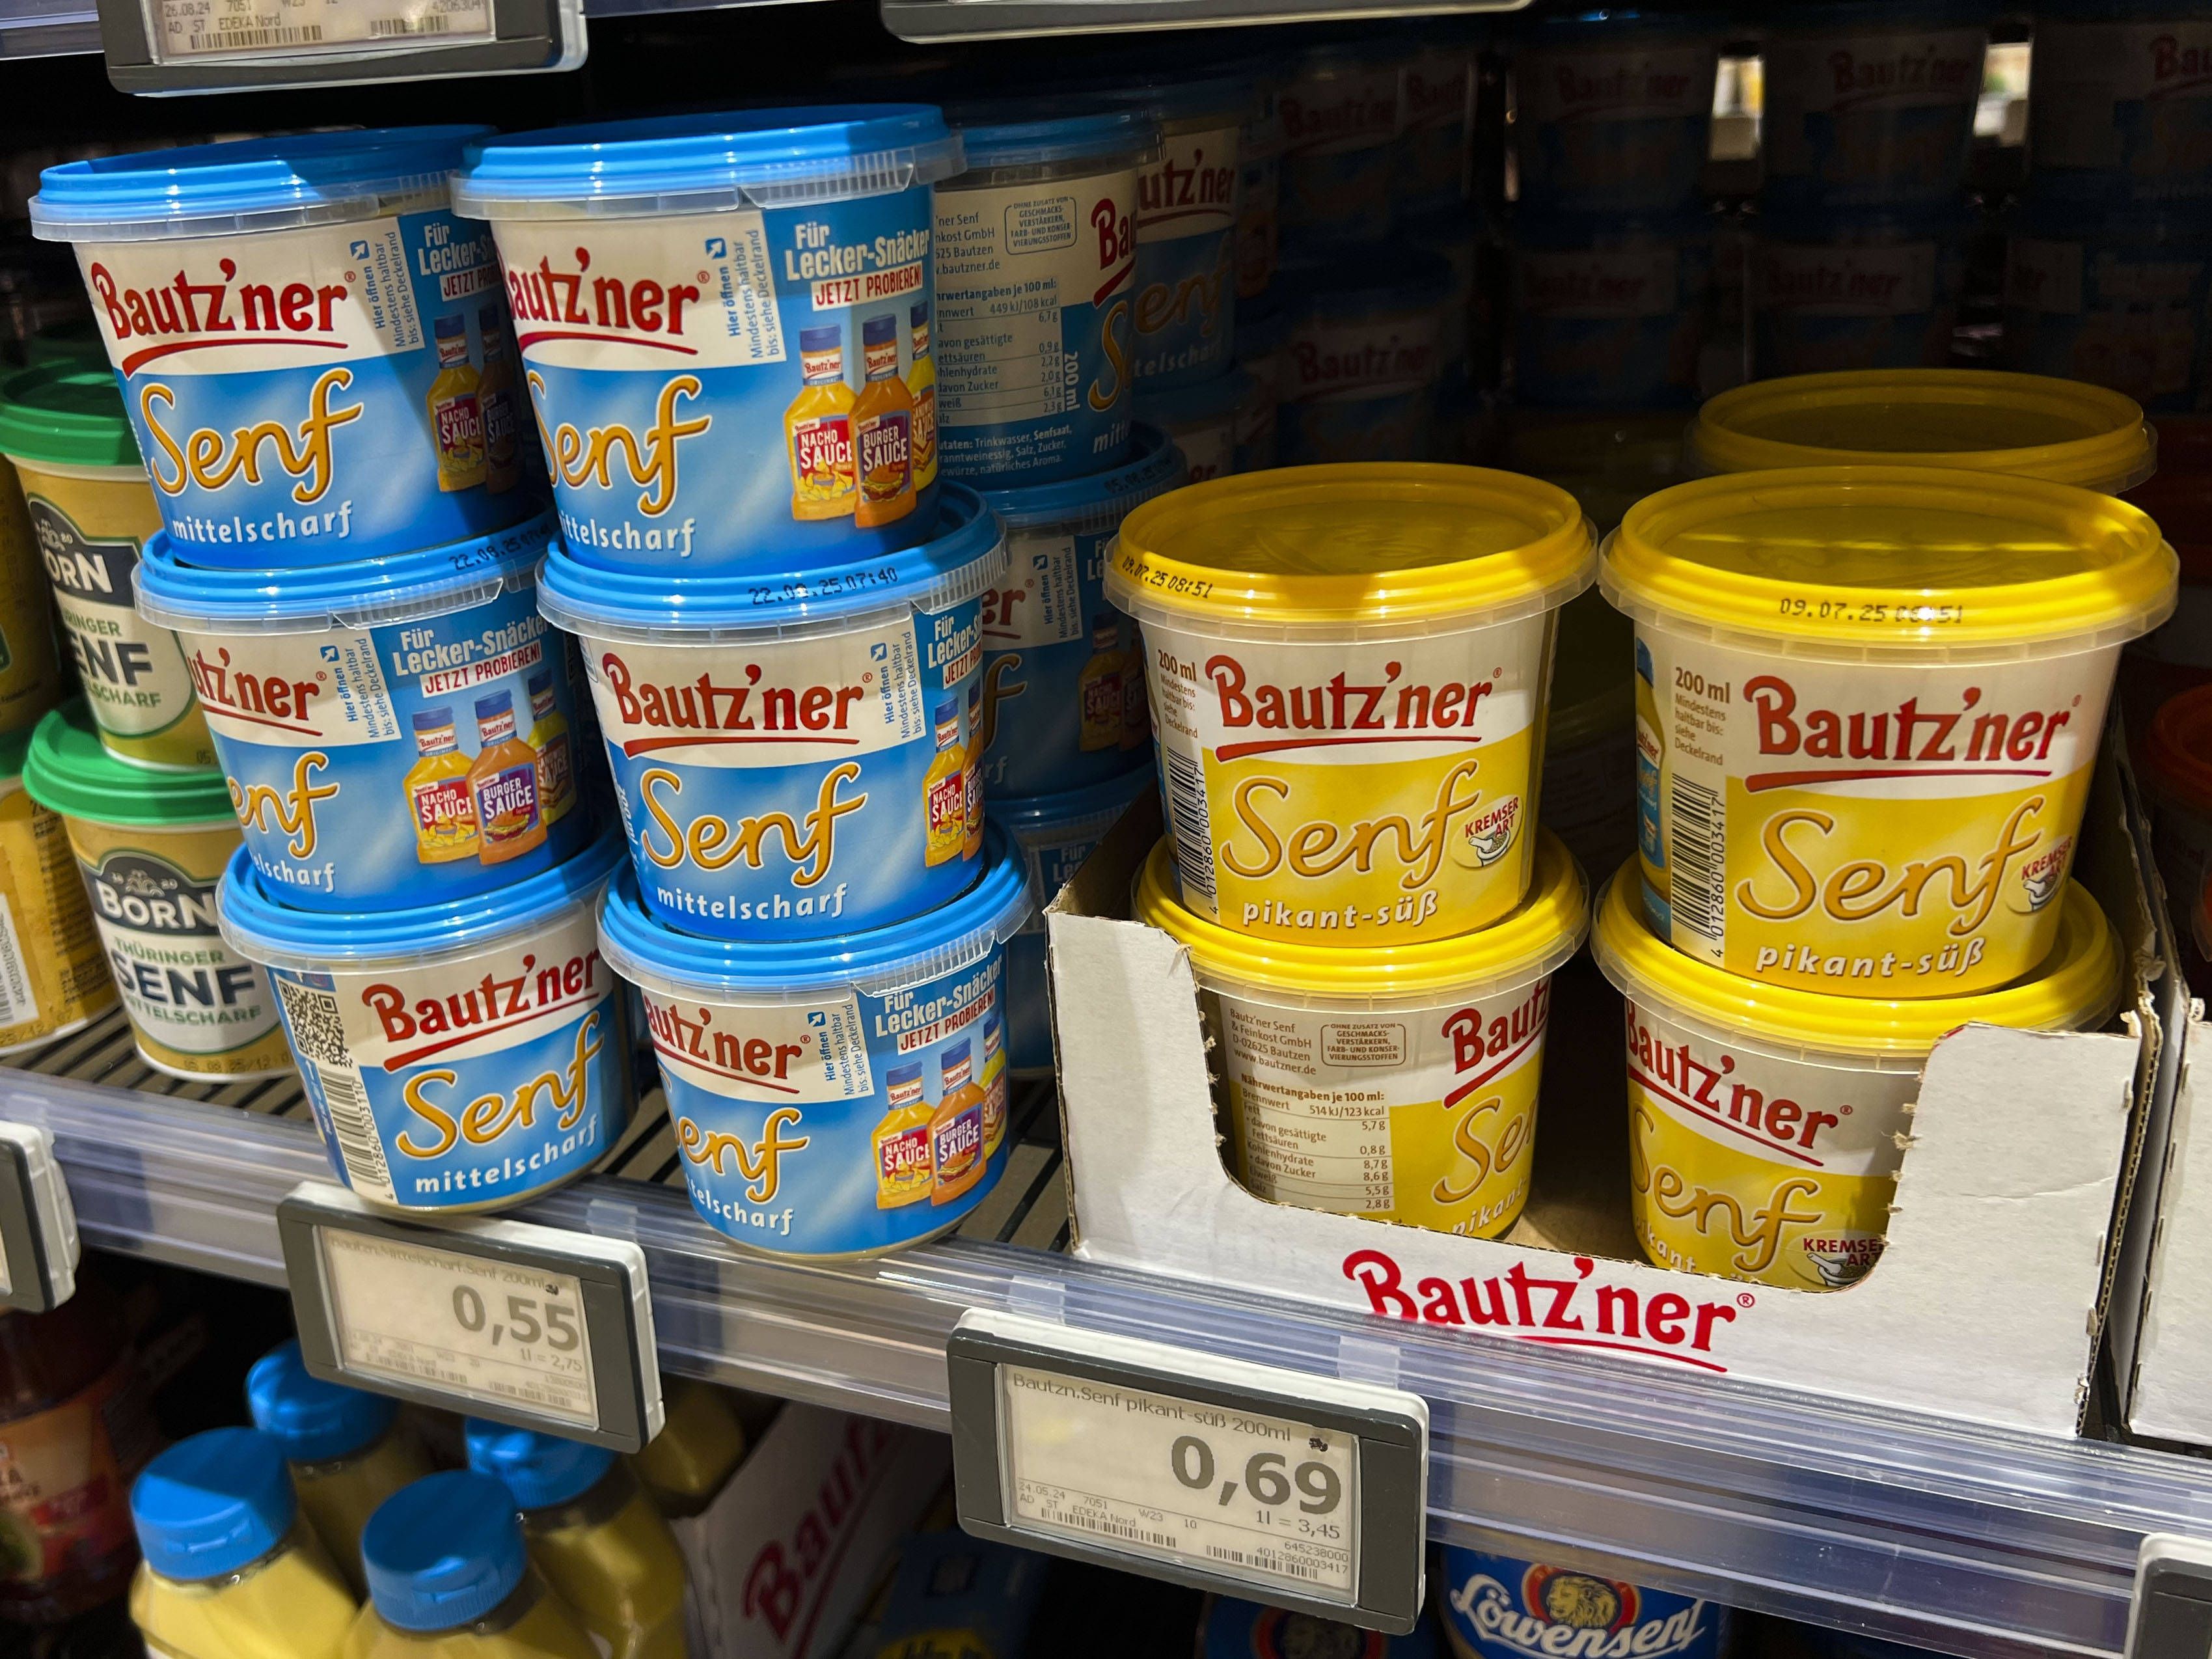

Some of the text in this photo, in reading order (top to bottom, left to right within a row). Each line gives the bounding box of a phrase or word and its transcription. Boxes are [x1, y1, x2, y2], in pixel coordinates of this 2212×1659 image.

[218, 16, 254, 31] EDEKA
[256, 13, 281, 27] Nord
[1138, 149, 1235, 212] utz'ner
[957, 212, 979, 225] Senf
[964, 228, 994, 240] GmbH
[424, 223, 449, 247] Für
[795, 221, 830, 249] Für
[746, 230, 769, 298] Deckelrand
[785, 230, 930, 281] Lecker-Snäcker
[954, 245, 994, 258] Bautzen
[385, 232, 416, 323] siehe Deckelrand
[444, 273, 474, 297] JETZT
[816, 265, 922, 306] JETZT PROBIEREN!
[92, 258, 347, 338] Bautz'ner
[364, 266, 385, 329] Hier öffnen
[375, 243, 405, 348] Mindestens haltbar
[720, 266, 741, 336] Hier öffnen
[740, 288, 761, 358] Mindestens
[964, 333, 1013, 349] gesättigte
[1064, 351, 1080, 411] 200 ml
[141, 368, 363, 504] Senf
[800, 430, 838, 448] NACHO
[863, 425, 899, 448] BURGER
[976, 434, 1032, 448] Trinkwasser,
[1016, 445, 1036, 457] Salz,
[863, 438, 907, 471] SAUCE
[980, 459, 1030, 474] natürliches
[173, 500, 353, 543] mittelscharf
[845, 567, 898, 589] 07:40
[1065, 546, 1075, 598] Deckelrand
[1121, 555, 1166, 589] 09.07.25
[1167, 577, 1214, 599] 08:51
[1041, 575, 1049, 603] öffnen
[1779, 598, 1888, 622] 09.07.25
[400, 629, 434, 651] Für
[935, 616, 954, 641] Für
[393, 616, 548, 676] Lecker-Snäcker
[901, 631, 918, 687] Deckelrand
[361, 638, 390, 719] siehe Deckelrand
[425, 668, 469, 694] JETZT
[946, 659, 970, 685] JETZT
[1158, 649, 1197, 681] 200 ml
[335, 668, 359, 722] Hier öffnen
[347, 648, 377, 739] Mindestens haltbar
[603, 653, 864, 731] Bautz'ner
[878, 666, 895, 724] Hier öffnen
[891, 644, 910, 738] Mindestens haltbar
[1205, 654, 1492, 730] Bautz'ner
[1675, 667, 1730, 704] 200 ml
[1674, 692, 1726, 721] Mindestens
[1674, 709, 1704, 732] haltbar
[1744, 675, 2071, 763] Bautz'ner
[1674, 724, 1695, 742] siehe
[1674, 739, 1723, 766] Deckelrand
[421, 789, 457, 806] NACHO
[483, 778, 521, 801] BURGER
[484, 789, 534, 819] SAUCE
[933, 789, 955, 806] NACHO
[640, 761, 868, 886] Senf
[1220, 758, 1481, 892] Senf
[1465, 797, 1518, 838] KREMSER
[1495, 814, 1515, 838] ART
[1734, 795, 2045, 937] Senf
[96, 881, 217, 928] BORN
[657, 883, 847, 919] mittelscharf
[1243, 889, 1438, 929] pikant-süß
[114, 936, 224, 965] THÜRINGER
[1755, 937, 1985, 978] pikant-süß
[111, 948, 255, 1006] SENF
[362, 947, 599, 1043] Bautz'ner
[875, 961, 1000, 1037] Lecker-Snäcker
[884, 991, 914, 1013] Für
[845, 1004, 860, 1051] Deckelrand
[901, 1026, 938, 1050] JETZT
[1240, 1025, 1311, 1049] Feinkost GmbH
[1274, 1023, 1295, 1034] Senf
[819, 1032, 832, 1062] öffnen
[832, 1013, 855, 1095] Mindestens haltbar
[1234, 1050, 1316, 1075] www.bautzner.de
[1270, 1046, 1310, 1062] Bautzen
[395, 1010, 604, 1161] Senf
[1241, 1073, 1365, 1104] Nährwertangaben je 100
[1628, 999, 1838, 1149] Bautz'ner
[1242, 1088, 1384, 1116] Brennwert kcal
[886, 1137, 917, 1155] NACHO
[939, 1125, 979, 1162] SAUCE
[940, 1119, 971, 1145] BURGER
[1252, 1129, 1298, 1150] Fettsäuren
[1278, 1123, 1327, 1144] gesättigte
[416, 1114, 599, 1194] mittelscharf
[1248, 1140, 1315, 1167] Kohlenhydrate
[1283, 1164, 1316, 1179] Zucker
[1632, 1106, 1822, 1272] Senf
[1343, 1249, 1736, 1352] Bautz'ner
[453, 1285, 579, 1351] 0,55
[552, 1354, 582, 1373] 2,75
[1013, 1373, 1291, 1442] Bautzn.Senf pikant-süß 200ml
[1172, 1435, 1341, 1515] 0,69
[1019, 1481, 1197, 1529] 24.05.24 7051 W23 10
[1046, 1499, 1136, 1527] ST EDEKA Nord
[1298, 1518, 1341, 1539] 3,45
[1256, 1546, 1349, 1574] 4012860003417
[1284, 1541, 1349, 1562] 645238000
[1450, 1574, 1707, 1658] Löwensenf
